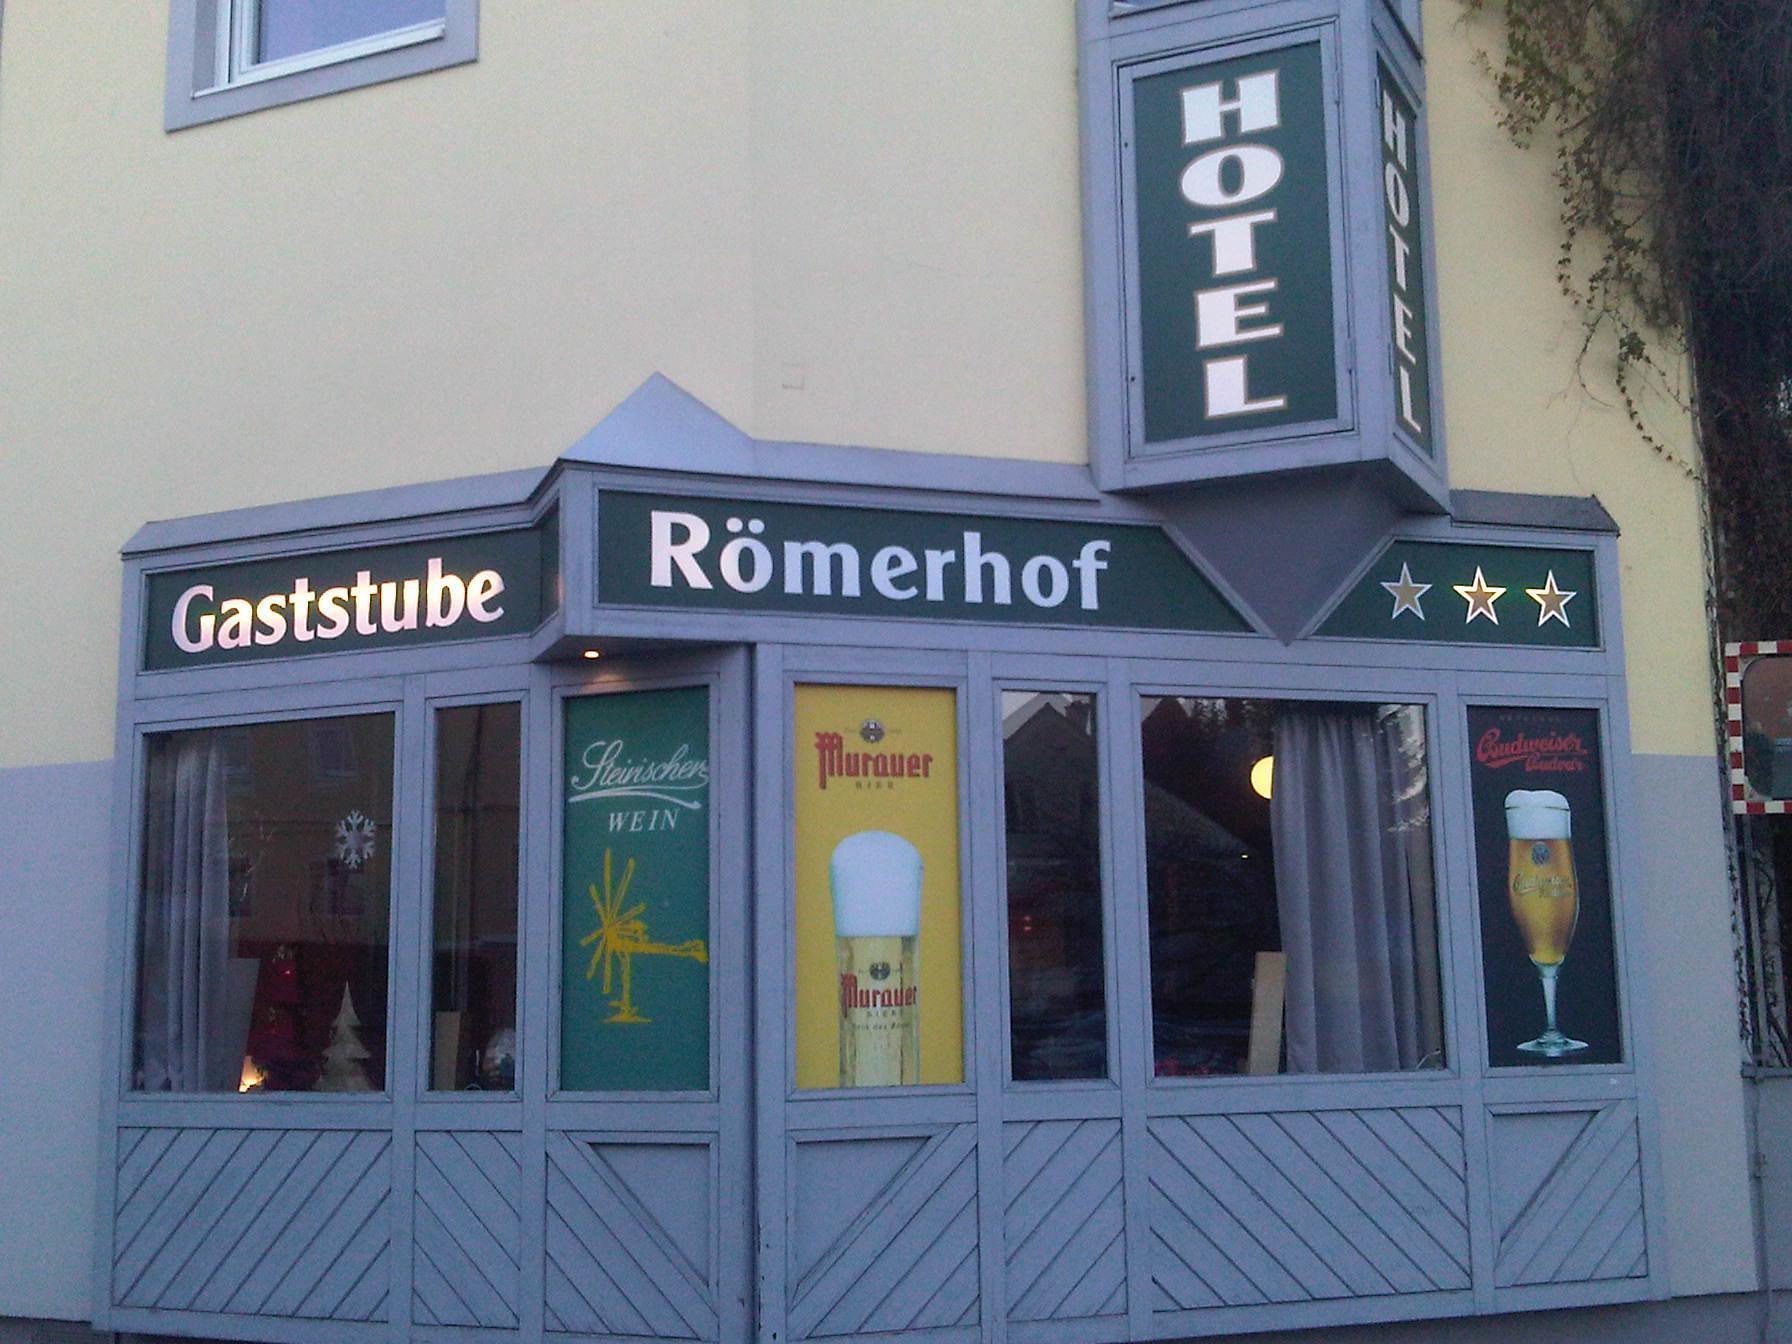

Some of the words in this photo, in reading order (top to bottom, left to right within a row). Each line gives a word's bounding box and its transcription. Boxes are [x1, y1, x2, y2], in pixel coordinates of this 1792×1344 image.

[1180, 69, 1286, 418] HOTEL
[1383, 90, 1421, 432] HOTEL
[172, 556, 505, 654] Gaststube
[650, 509, 1111, 611] Römerhof
[814, 731, 933, 790] Murauer
[608, 808, 680, 832] WEIN
